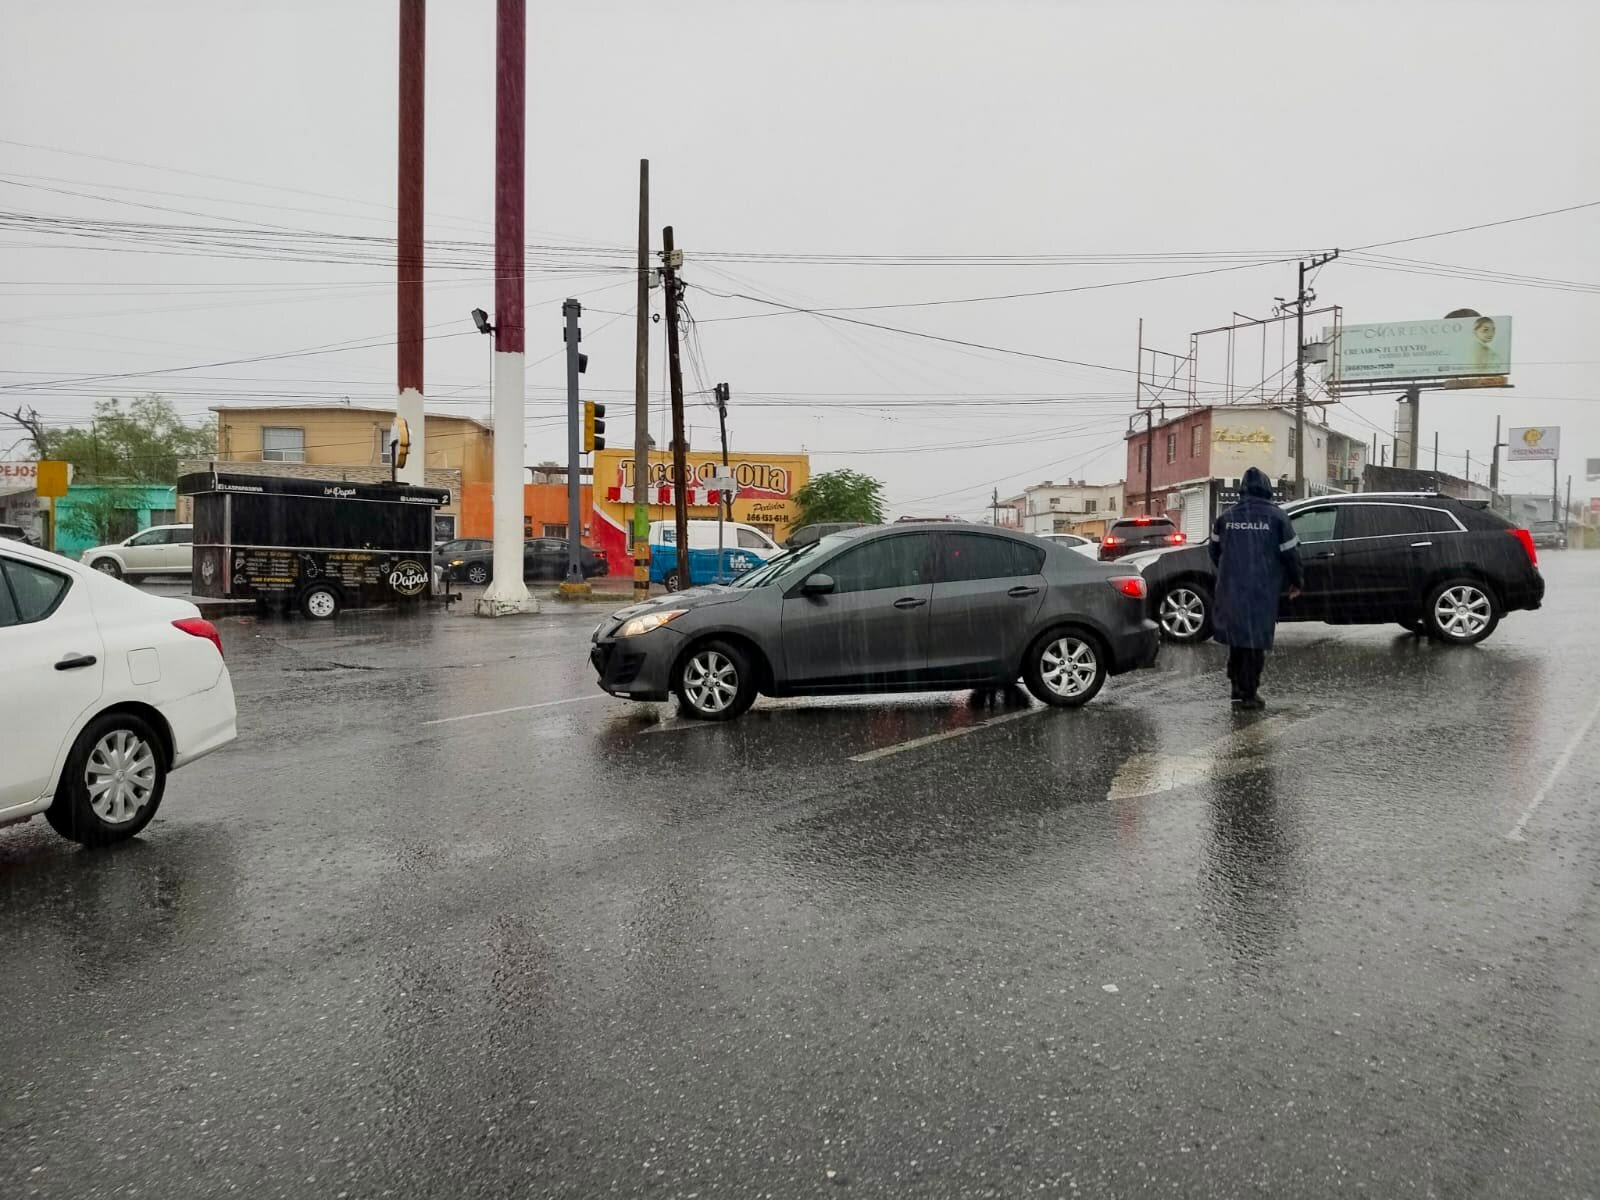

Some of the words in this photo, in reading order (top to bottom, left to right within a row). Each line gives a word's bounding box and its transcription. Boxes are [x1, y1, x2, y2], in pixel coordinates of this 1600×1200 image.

[736, 463, 786, 493] Olla
[333, 486, 356, 498] Papas
[753, 501, 785, 512] Pedidos
[1225, 521, 1270, 530] FISCALÍA
[389, 571, 429, 588] Papas
